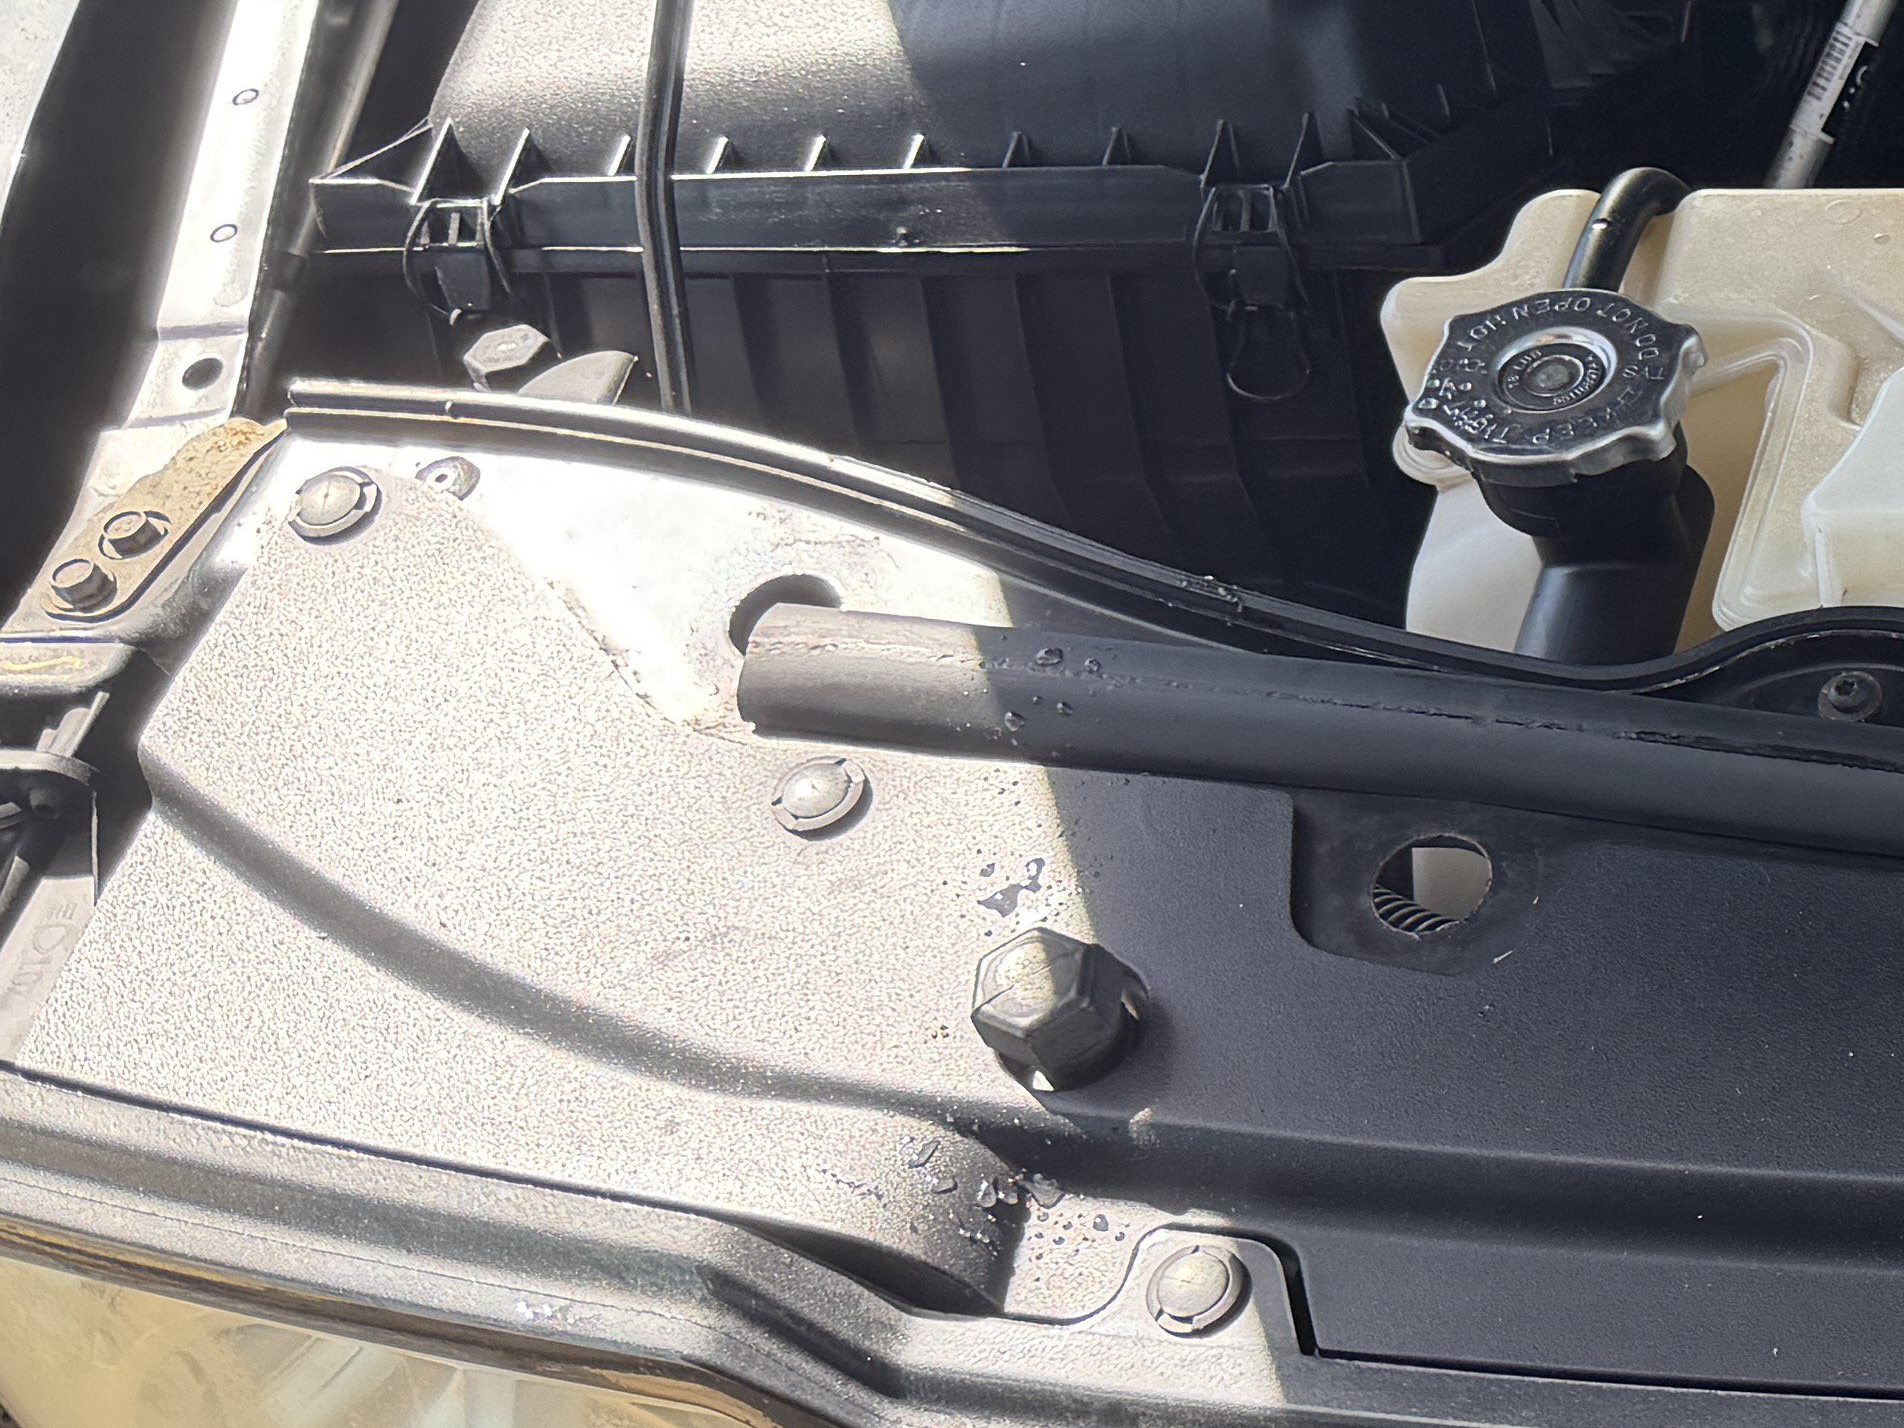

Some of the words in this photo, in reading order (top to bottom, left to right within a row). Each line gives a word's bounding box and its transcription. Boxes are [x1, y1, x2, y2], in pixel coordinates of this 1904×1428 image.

[1512, 297, 1591, 321] OPEN
[1597, 301, 1650, 335] NOT
[1456, 314, 1506, 352] HOT
